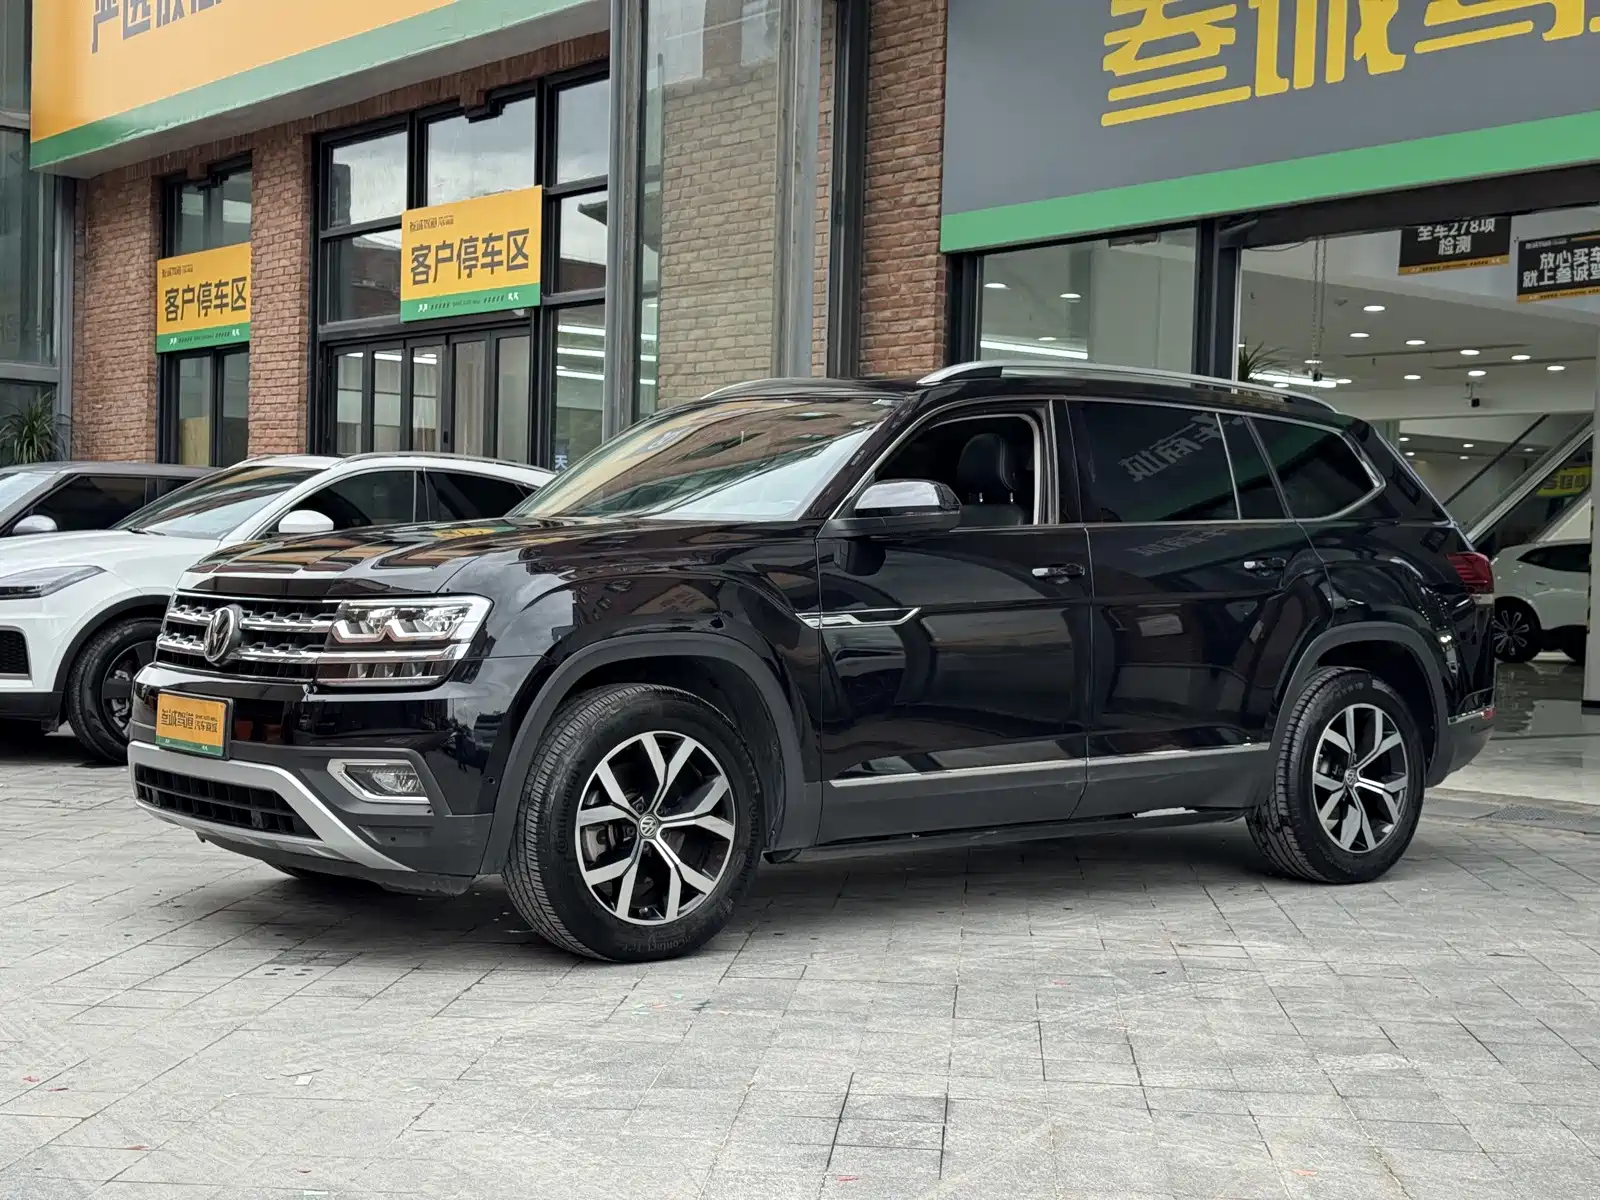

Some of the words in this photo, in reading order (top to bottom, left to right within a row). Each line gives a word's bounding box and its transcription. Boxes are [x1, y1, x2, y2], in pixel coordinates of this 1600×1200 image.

[410, 227, 530, 287] 客户停车区
[1438, 234, 1472, 256] 检测
[164, 275, 247, 322] 客户停车区
